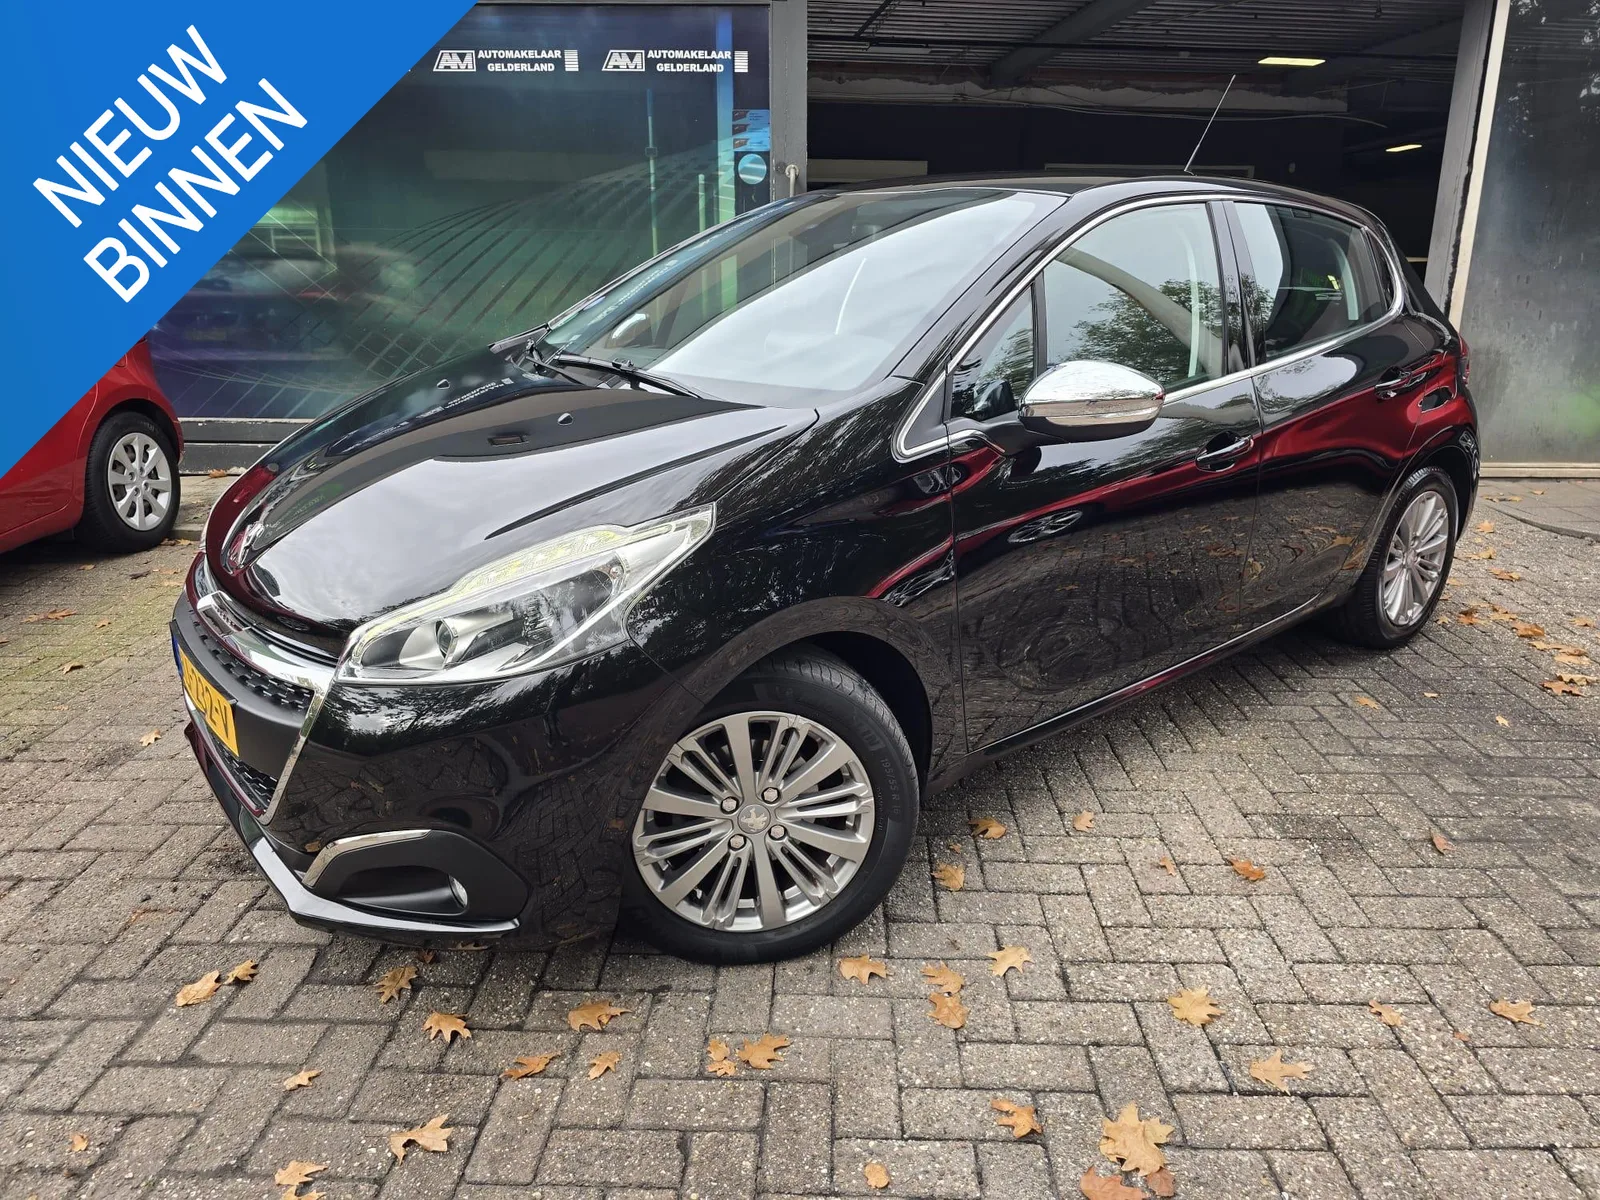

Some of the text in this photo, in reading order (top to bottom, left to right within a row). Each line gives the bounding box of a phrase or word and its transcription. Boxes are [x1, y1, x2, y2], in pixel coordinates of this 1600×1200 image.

[477, 49, 562, 59] AUTOMAKELAAR
[647, 50, 732, 60] AUTOMAKELAAR
[436, 52, 475, 70] AM
[605, 52, 643, 70] AM
[487, 63, 555, 72] GELDERLAND
[656, 63, 724, 73] GELDERLAND
